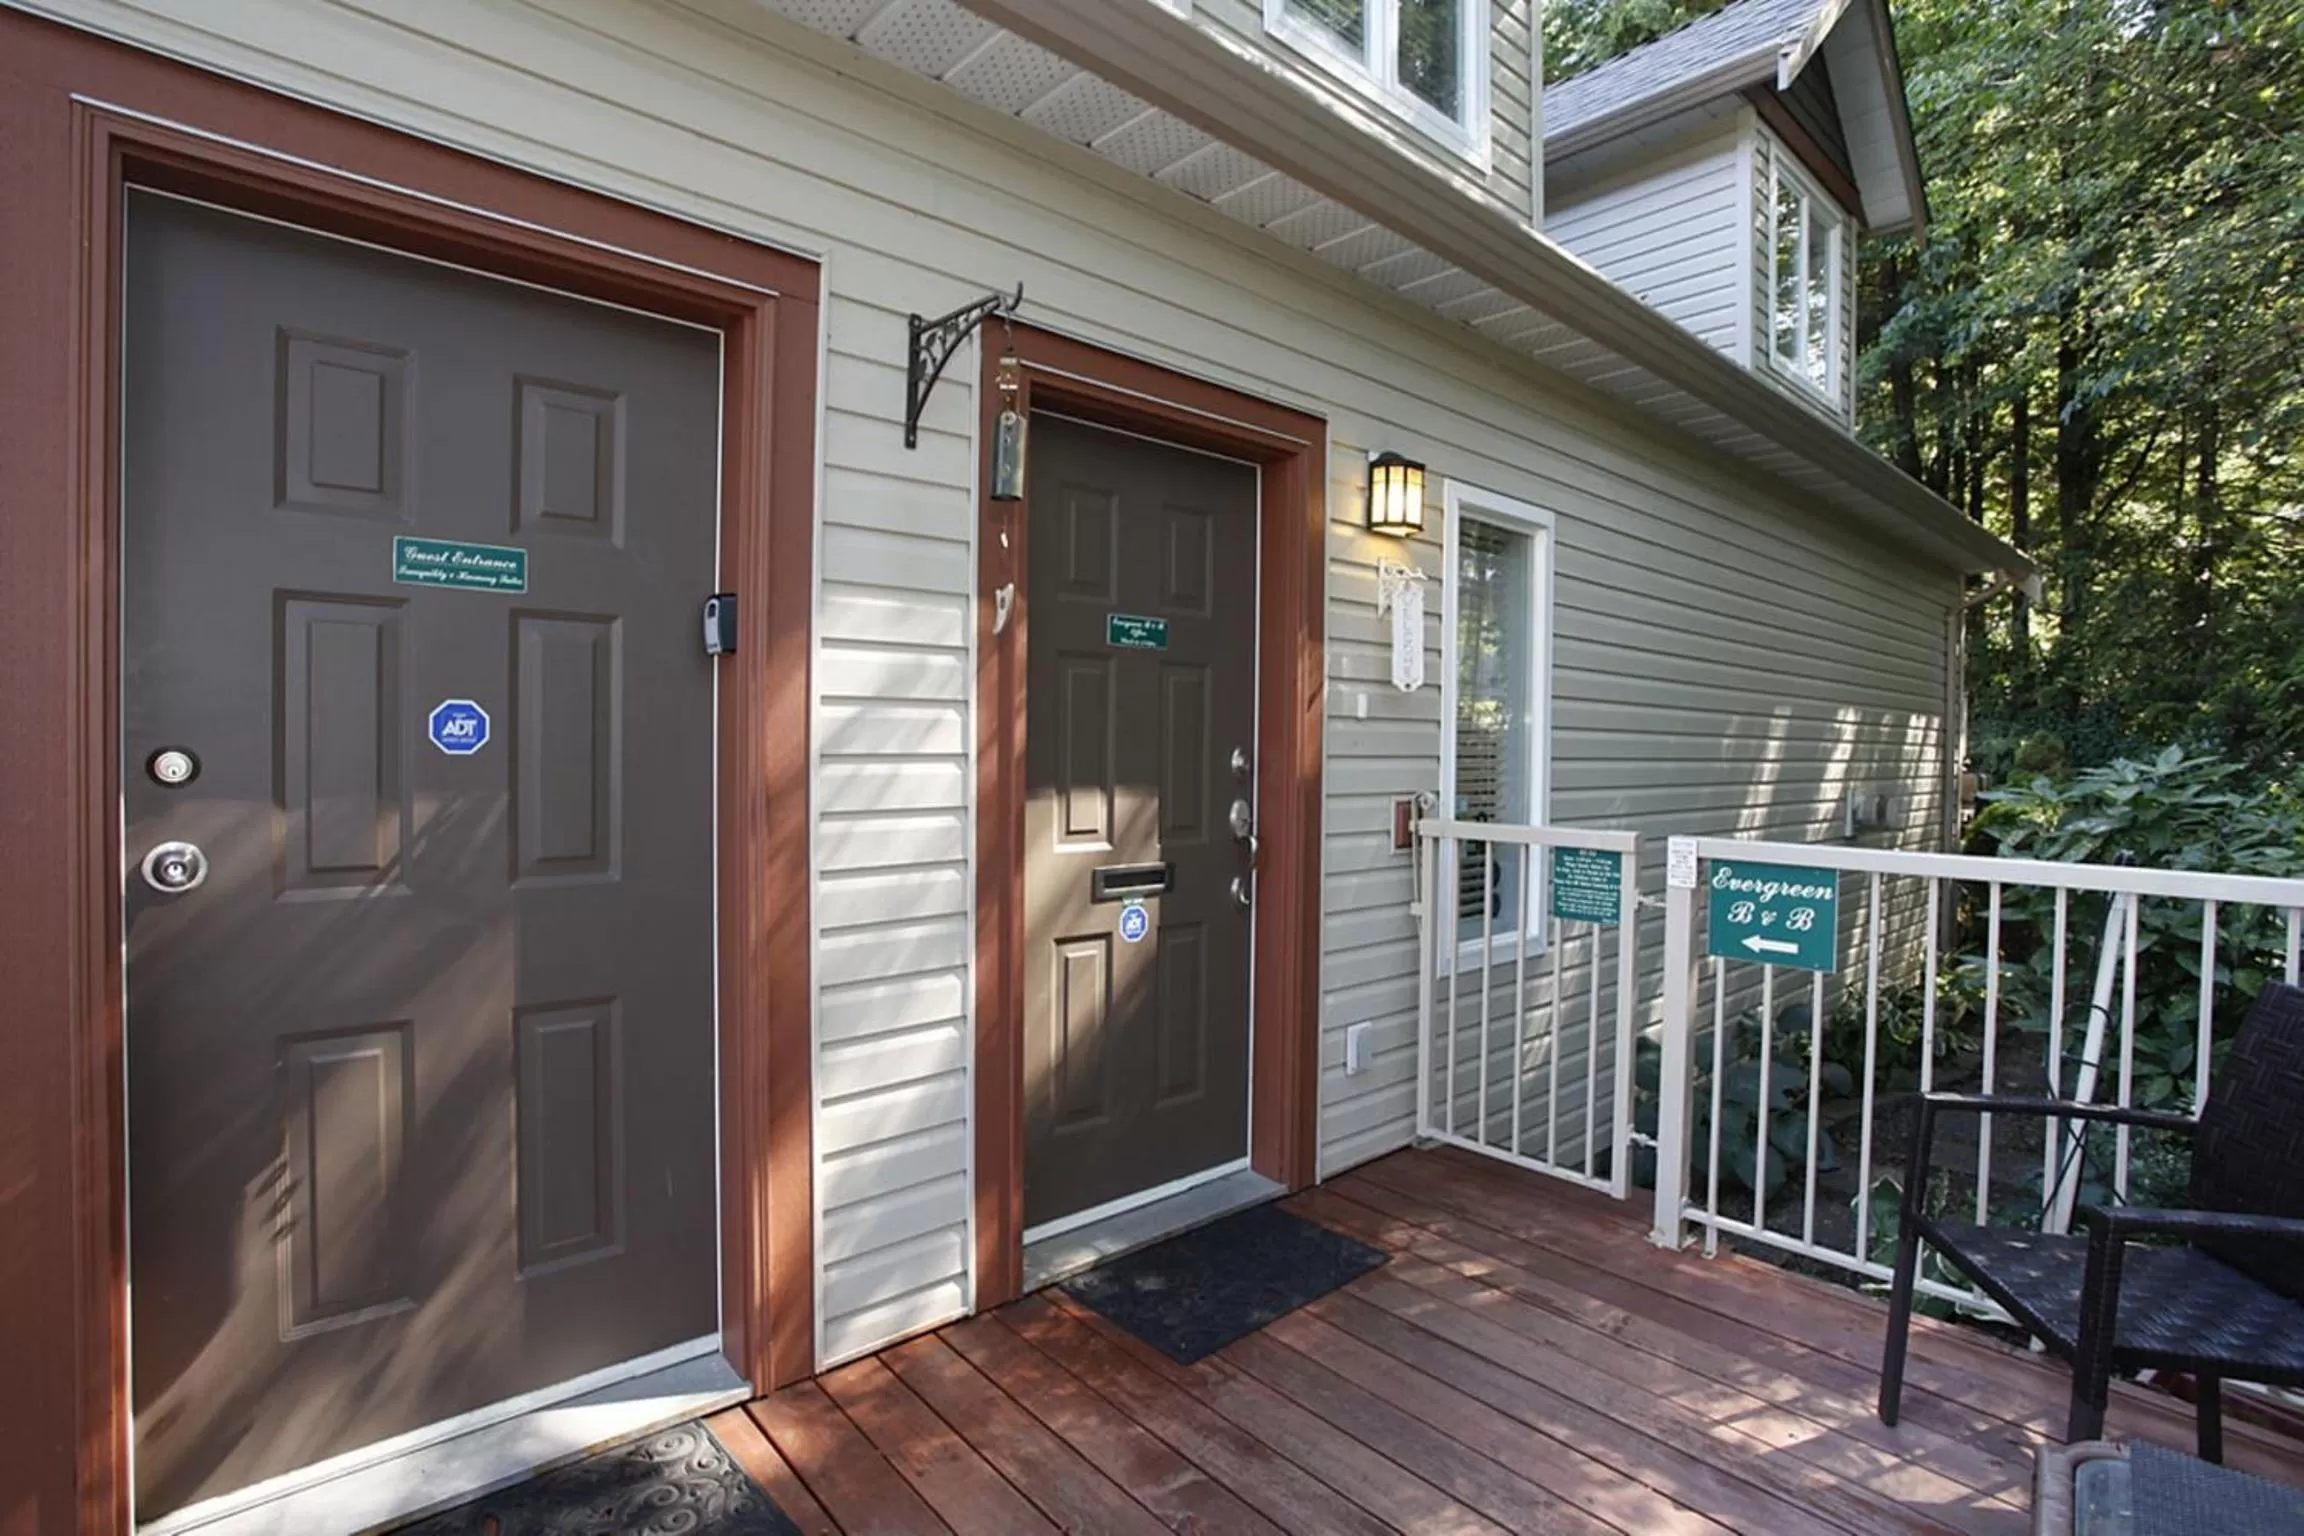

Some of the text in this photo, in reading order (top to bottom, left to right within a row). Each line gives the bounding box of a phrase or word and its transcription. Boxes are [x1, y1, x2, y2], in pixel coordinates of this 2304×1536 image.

[403, 546, 517, 568] Guest Entrance
[442, 719, 477, 736] ADT
[1712, 867, 1835, 903] Evergreen
[1728, 901, 1815, 931] B & B
